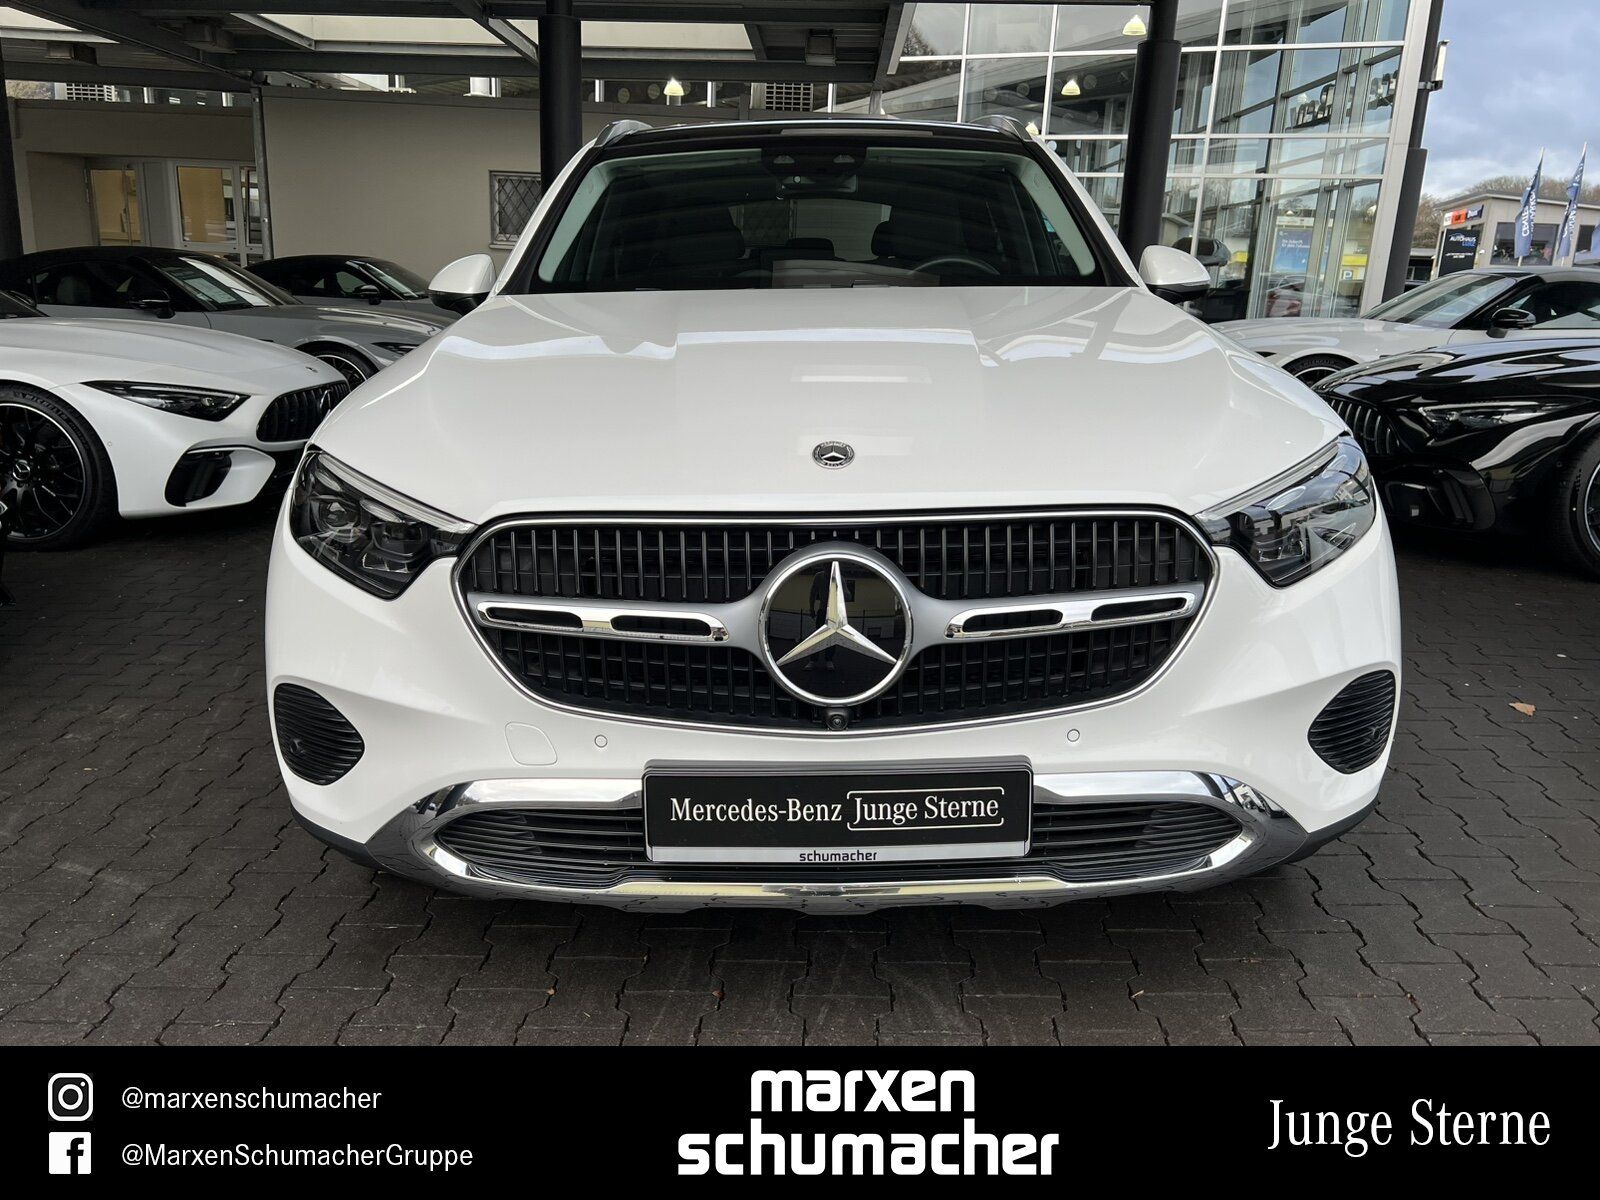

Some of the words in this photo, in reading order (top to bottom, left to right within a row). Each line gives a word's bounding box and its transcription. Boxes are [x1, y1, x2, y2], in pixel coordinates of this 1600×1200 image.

[1343, 270, 1353, 280] P
[670, 797, 842, 822] Mercedes-Benz
[852, 797, 918, 826] Junge
[923, 795, 999, 820] Sterne
[798, 849, 878, 863] schumacher
